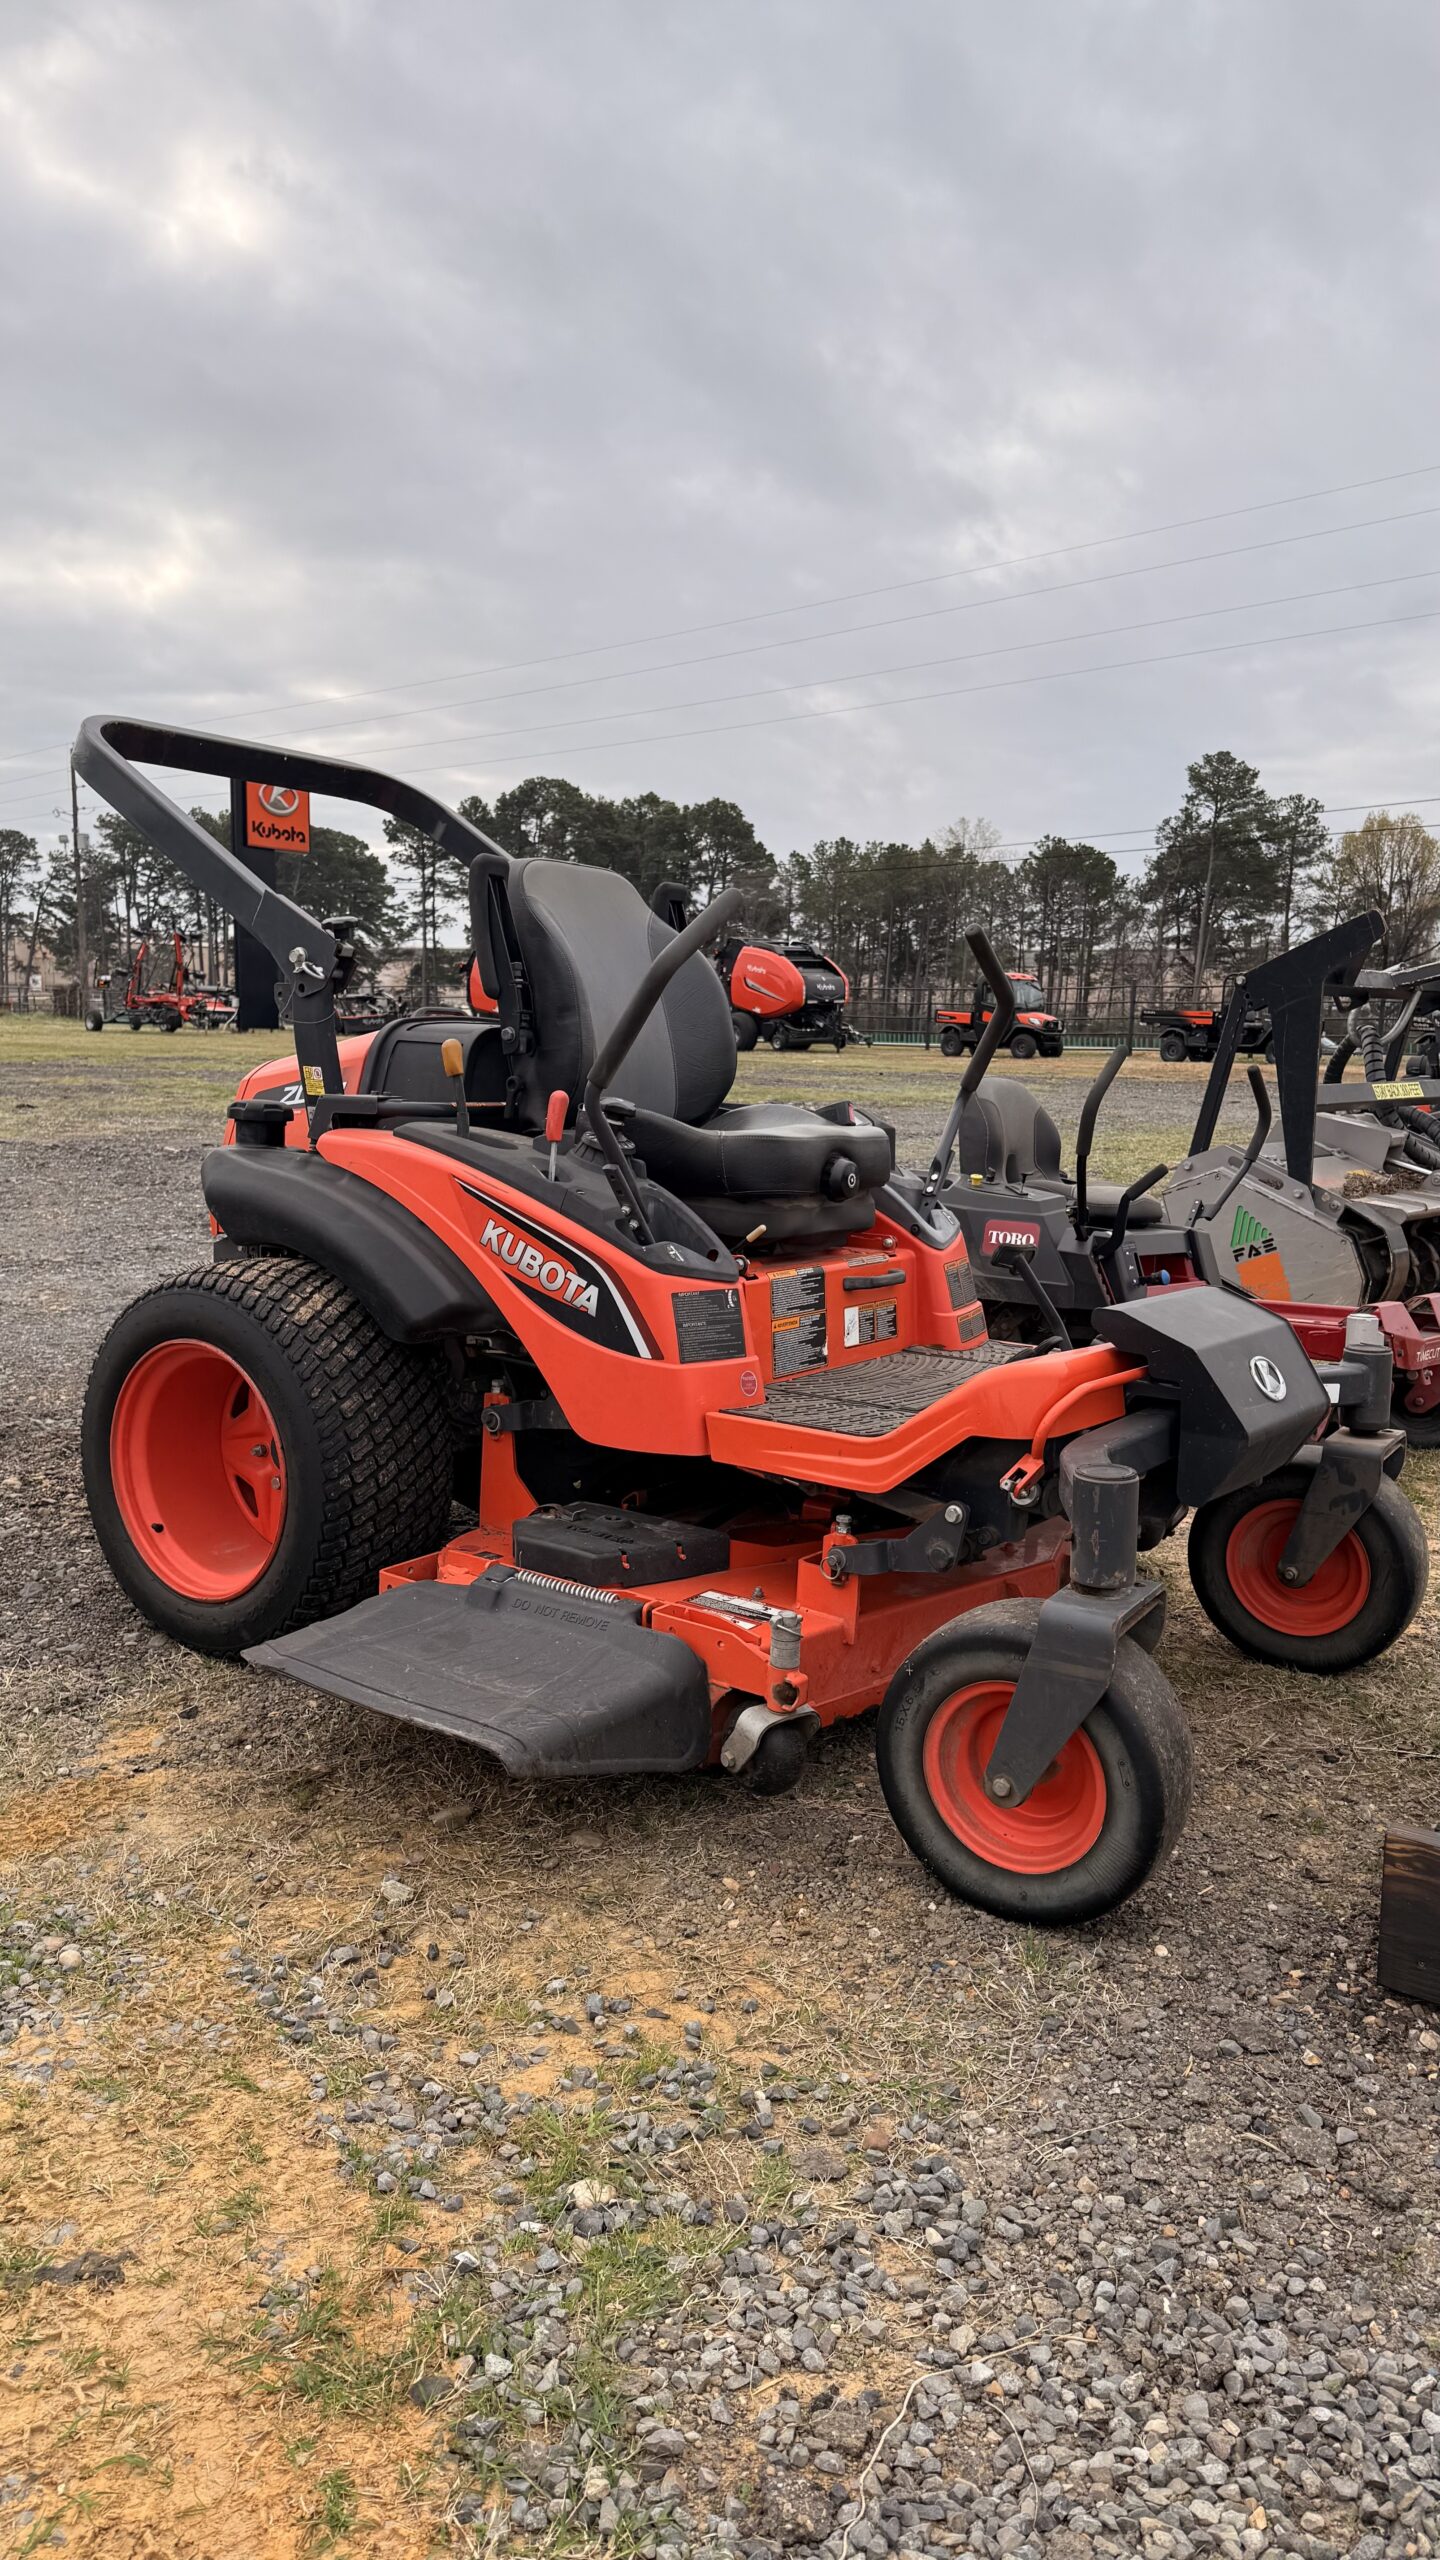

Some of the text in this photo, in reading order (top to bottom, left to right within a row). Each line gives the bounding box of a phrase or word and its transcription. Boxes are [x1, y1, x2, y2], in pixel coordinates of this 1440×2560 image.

[252, 820, 306, 843] Kubota
[988, 1230, 1035, 1245] TORO
[1232, 1237, 1277, 1262] FAE
[480, 1218, 600, 1318] KUBOTA
[512, 1598, 611, 1631] DO NOT REMOVE
